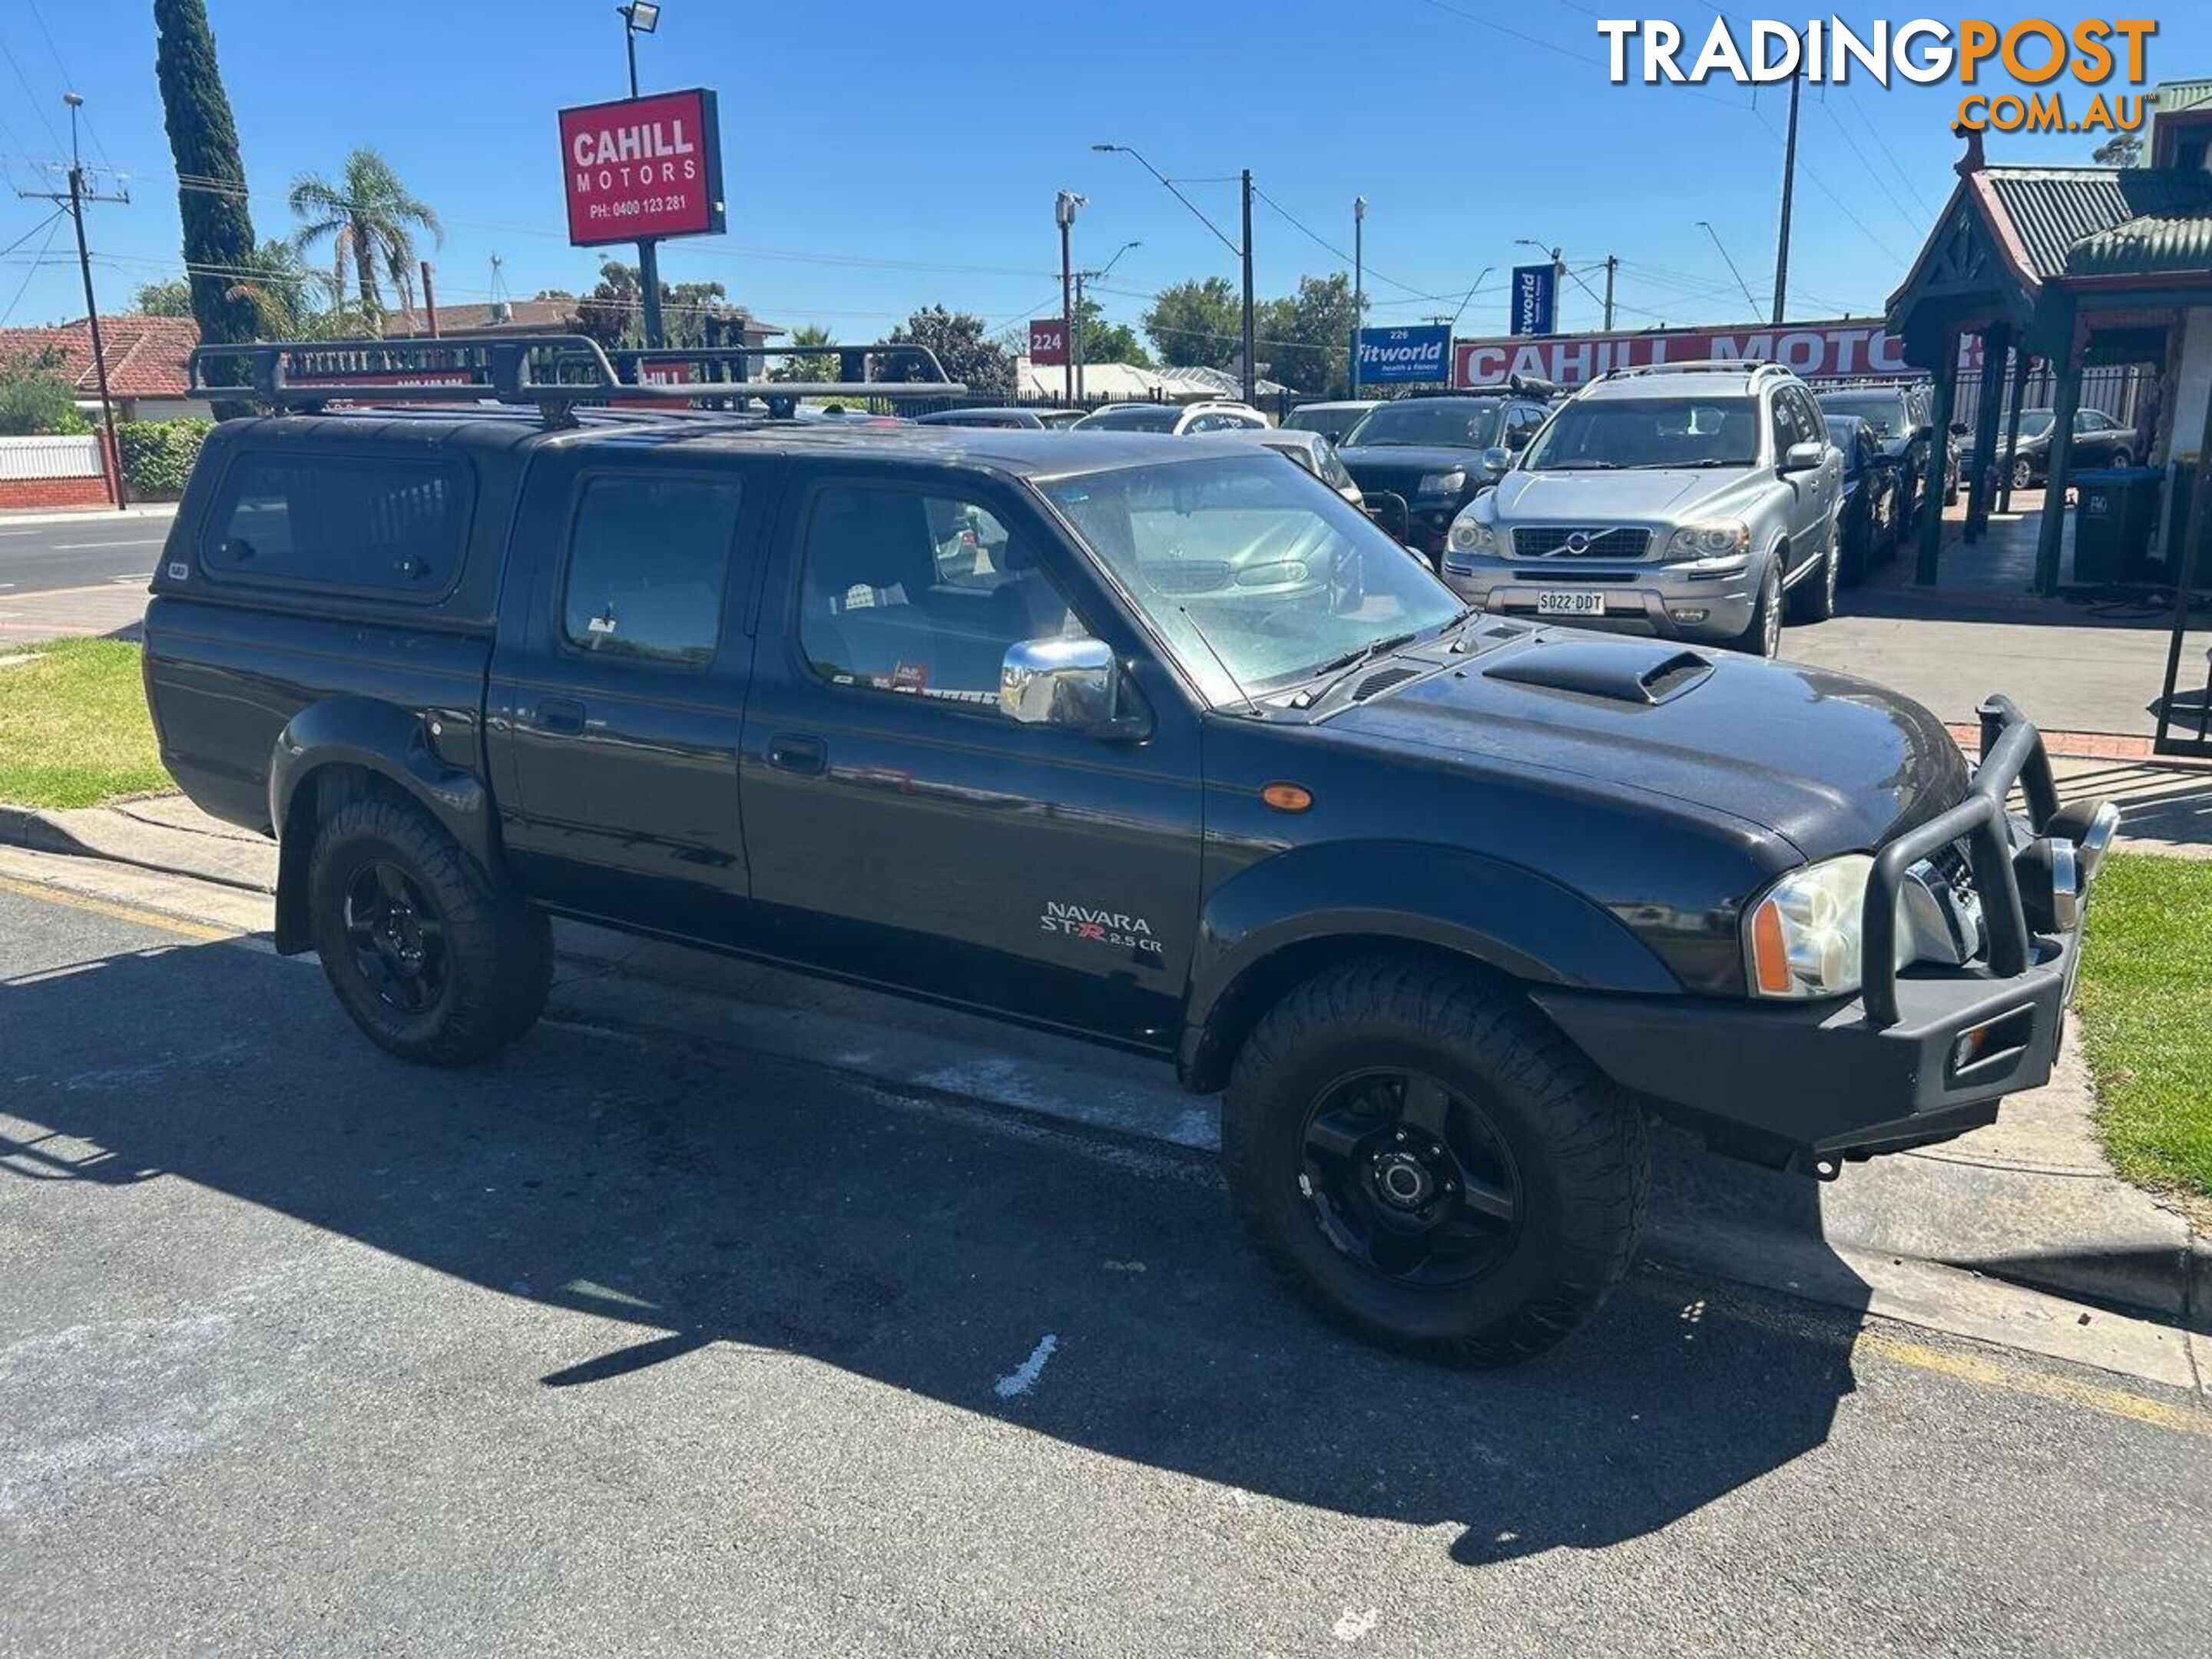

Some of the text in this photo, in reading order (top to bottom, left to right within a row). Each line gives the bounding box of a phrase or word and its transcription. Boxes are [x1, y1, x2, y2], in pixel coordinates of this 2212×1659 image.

[574, 120, 694, 167] CAHILL
[577, 160, 695, 192] MOTORS
[590, 195, 686, 219] PH: 0400 123 281
[1032, 333, 1061, 350] 224
[1047, 901, 1151, 935] NAVARA
[1110, 932, 1135, 947] 2.5
[1139, 939, 1162, 953] CR
